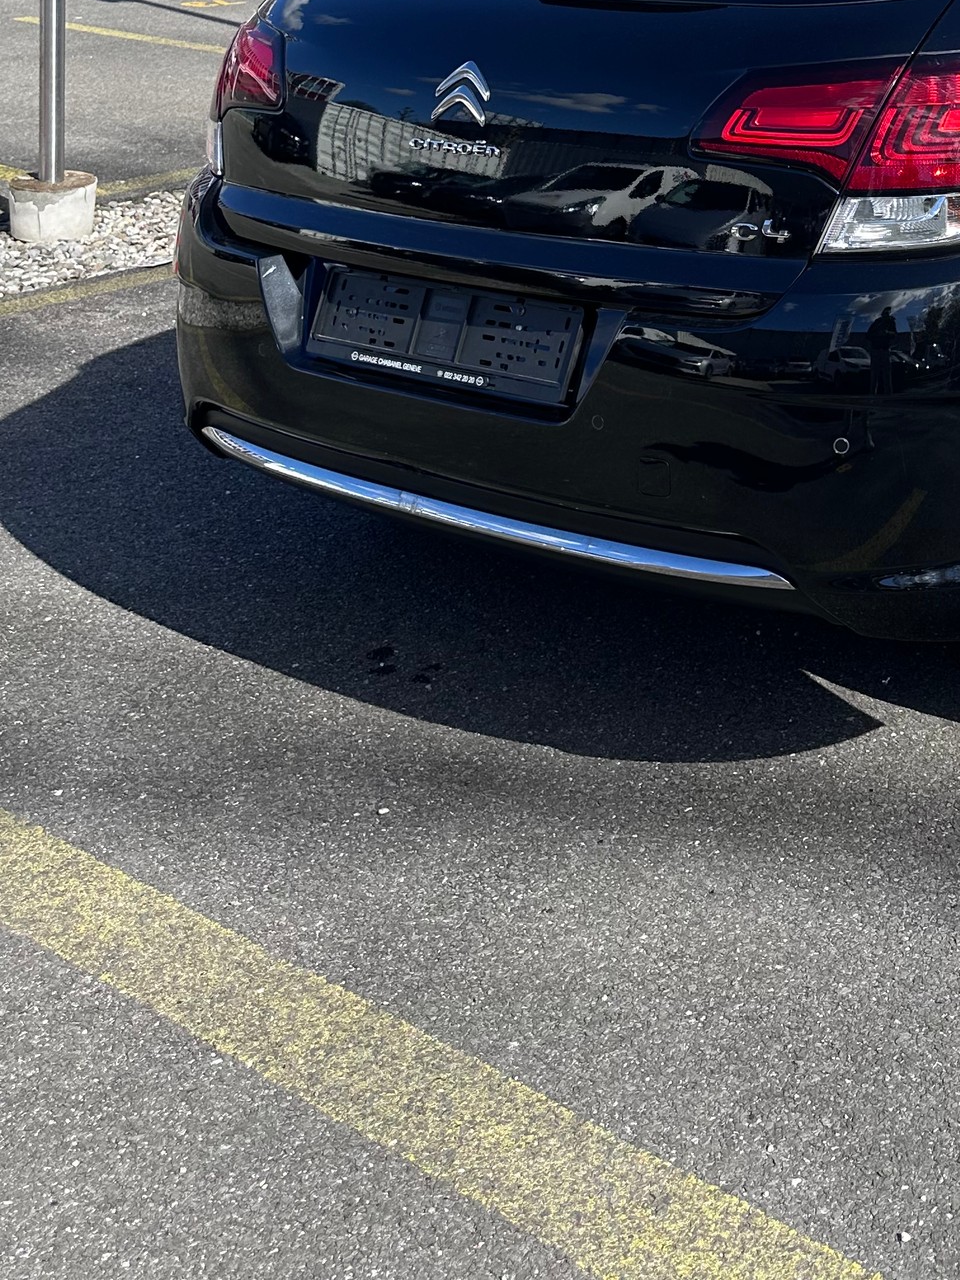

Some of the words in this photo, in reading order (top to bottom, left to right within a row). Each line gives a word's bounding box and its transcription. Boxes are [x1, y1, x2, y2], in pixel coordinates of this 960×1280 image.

[408, 138, 501, 157] CITROËN
[731, 219, 791, 243] C4
[358, 353, 378, 364] GARAGE
